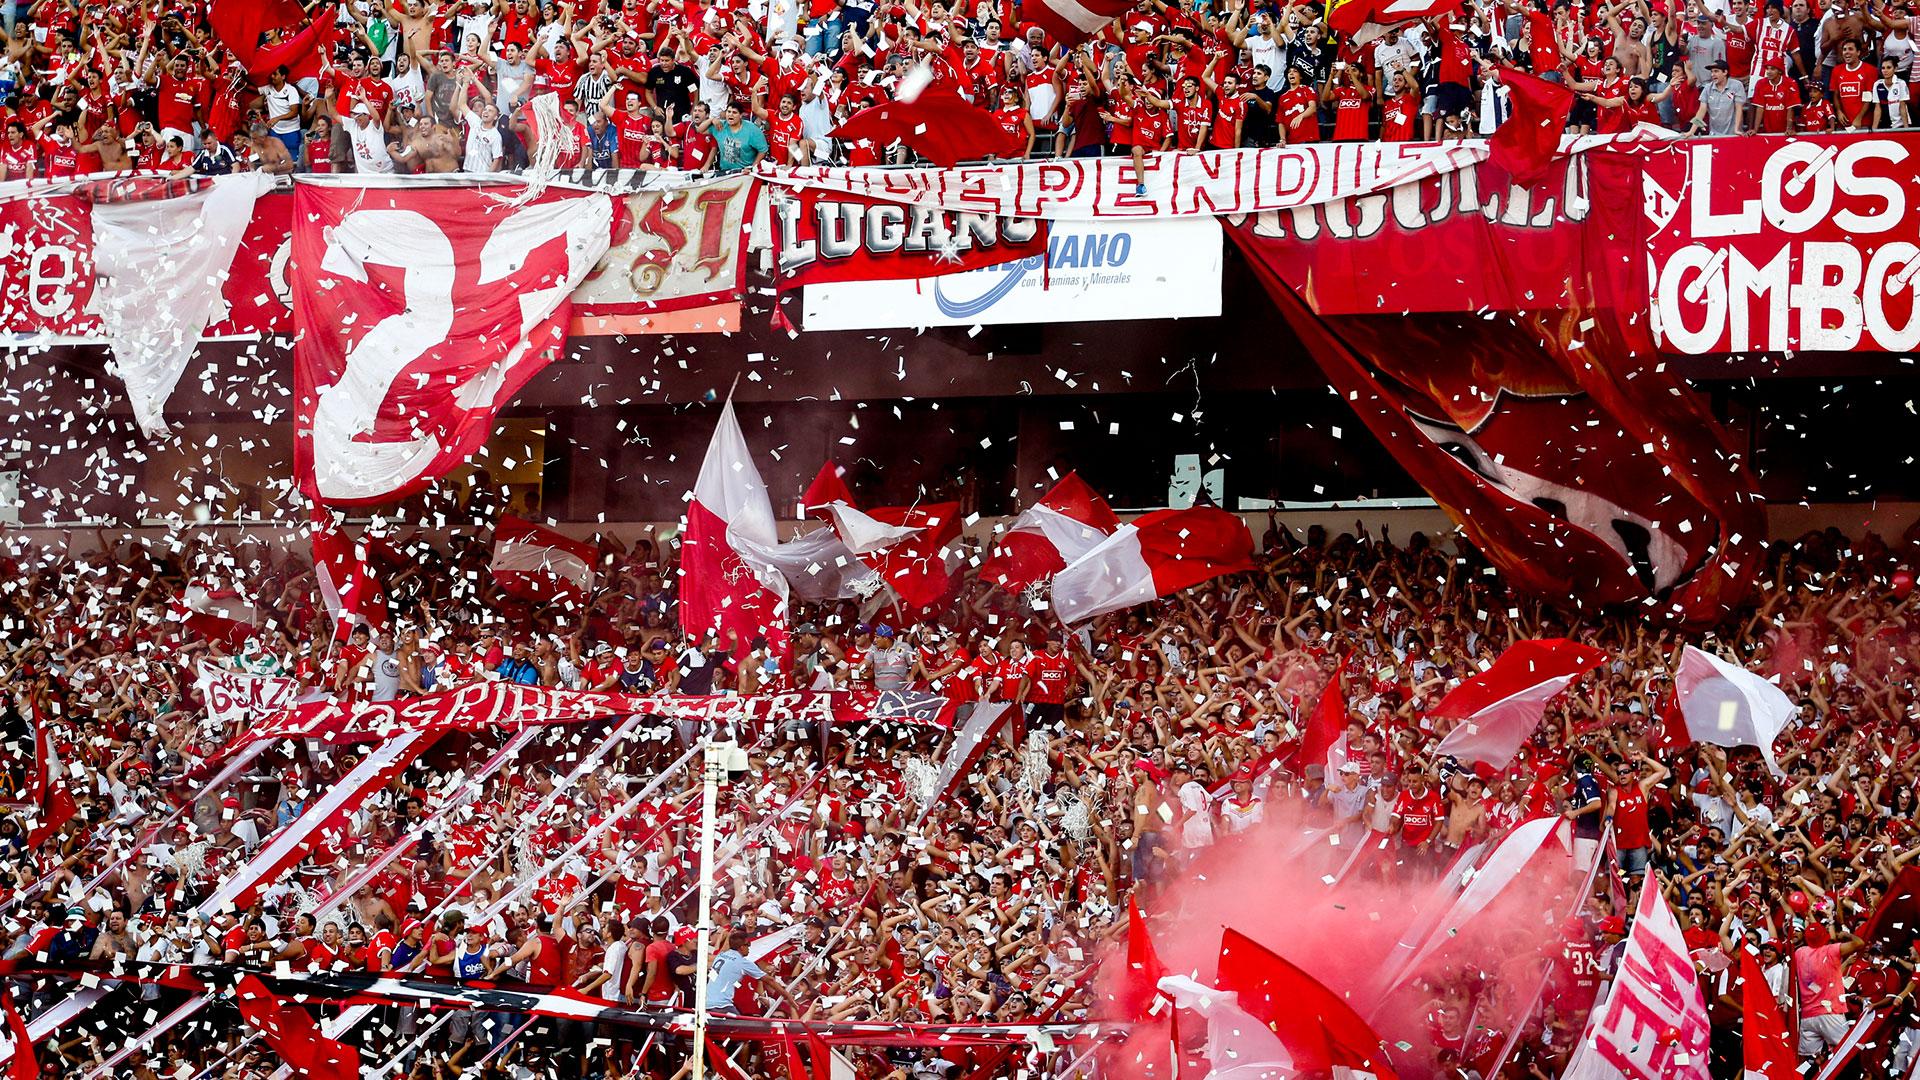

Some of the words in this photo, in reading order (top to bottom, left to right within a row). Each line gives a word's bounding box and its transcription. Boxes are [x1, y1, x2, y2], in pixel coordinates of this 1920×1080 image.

[1691, 140, 1910, 238] LOS
[1021, 276, 1036, 287] con
[1039, 274, 1080, 287] Vtaminas
[1089, 273, 1131, 285] Minerales
[1646, 240, 1920, 355] OMBO
[1571, 950, 1593, 975] 32
[764, 1048, 778, 1057] TCL
